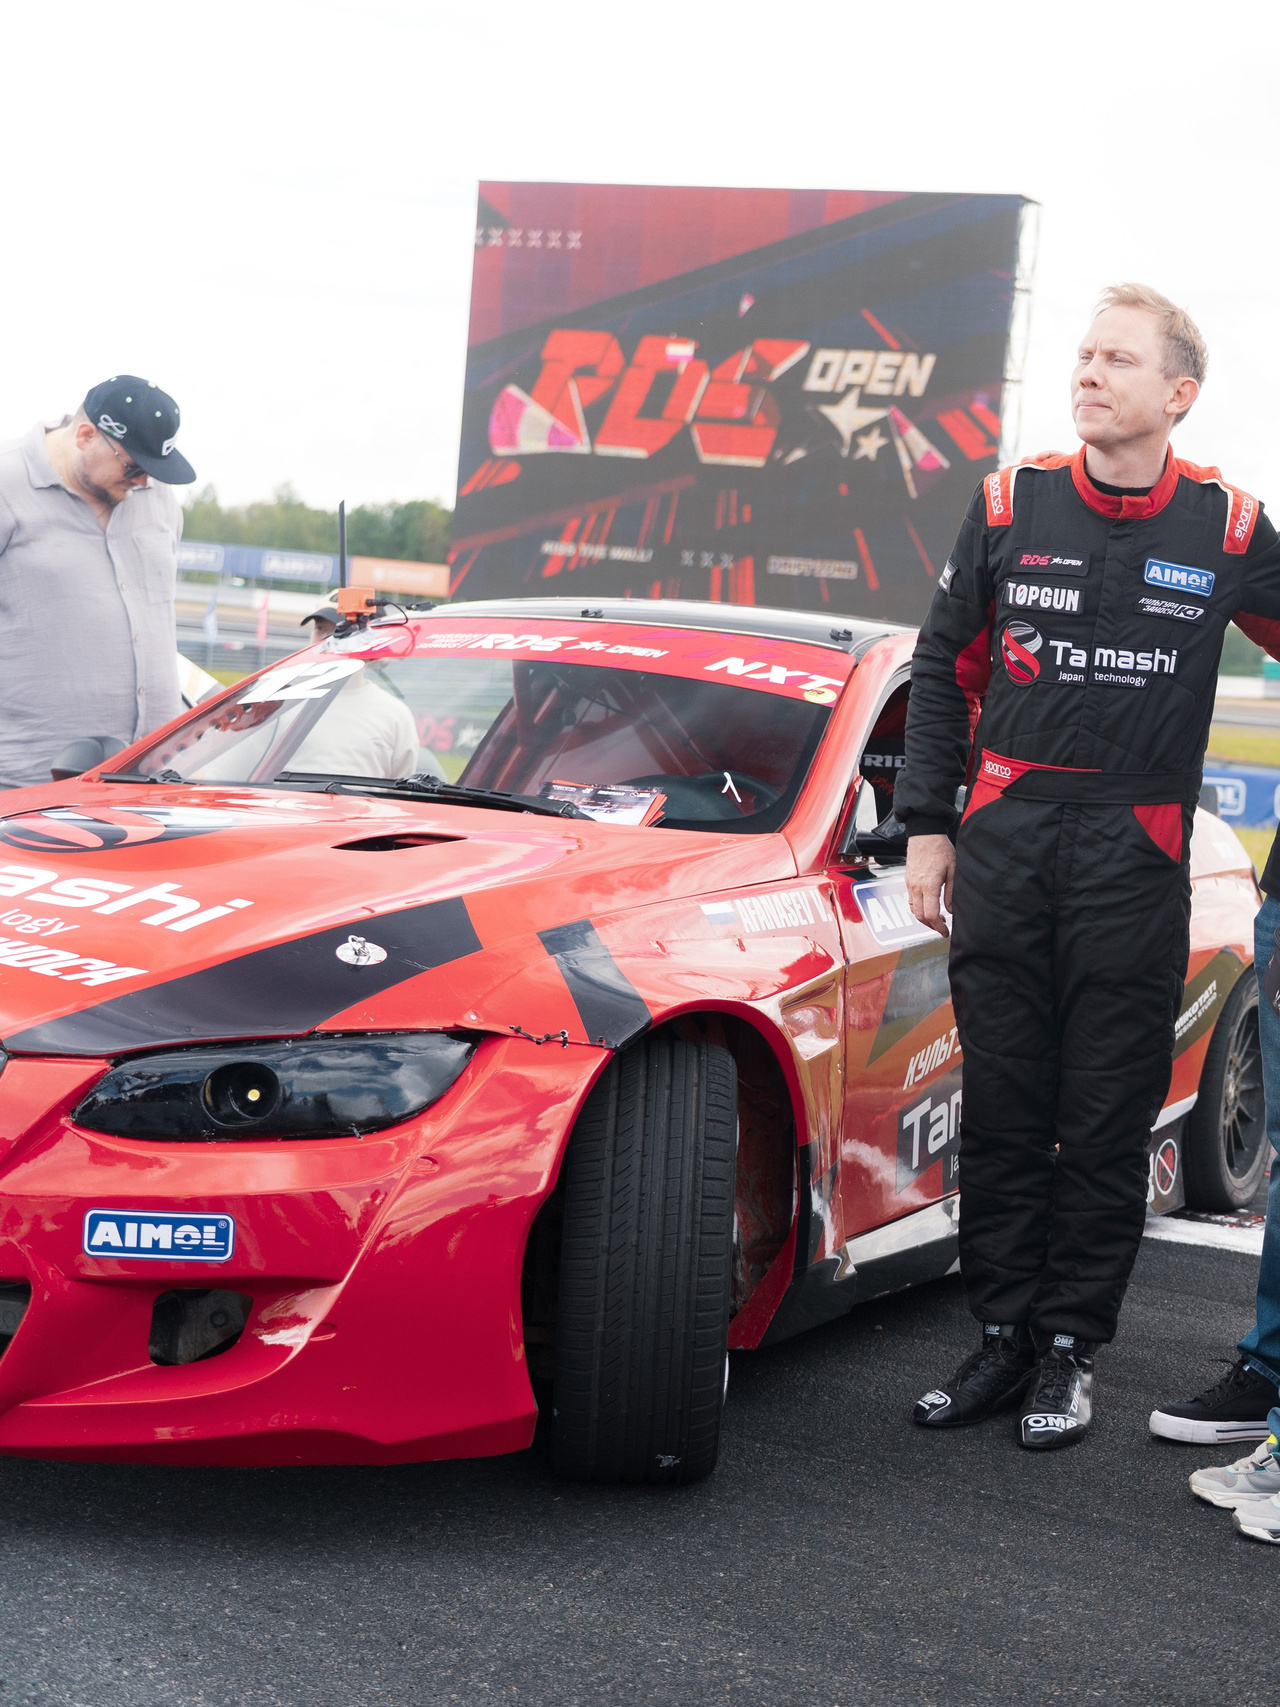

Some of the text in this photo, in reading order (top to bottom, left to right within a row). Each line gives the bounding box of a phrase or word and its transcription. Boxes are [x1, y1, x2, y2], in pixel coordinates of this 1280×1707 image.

[803, 348, 937, 396] OPEN
[988, 474, 1004, 516] sparco
[1234, 495, 1253, 541] sparco
[1019, 554, 1083, 567] RDS OPEN
[1147, 564, 1211, 592] AIMOL
[467, 633, 670, 658] RDS OPEN
[703, 656, 846, 692] NXT
[1058, 671, 1147, 687] Japan technology
[984, 760, 1012, 779] sparco
[90, 1220, 226, 1251] AIMOL
[985, 1324, 1000, 1334] OMP
[1053, 1335, 1075, 1347] OMP
[1027, 1416, 1078, 1431] OMP
